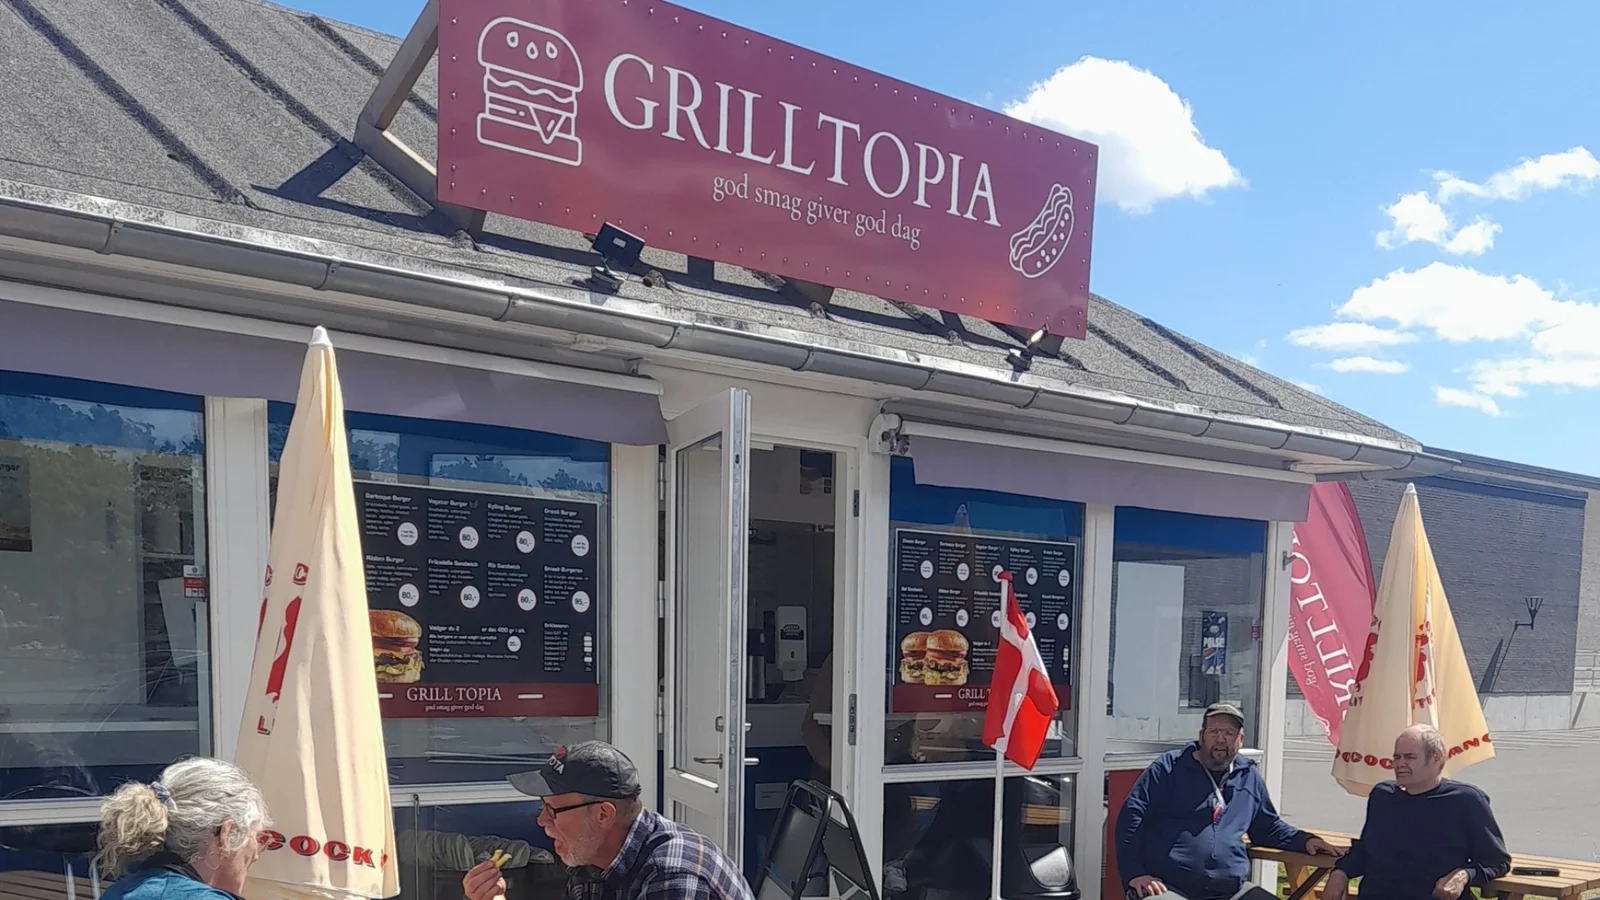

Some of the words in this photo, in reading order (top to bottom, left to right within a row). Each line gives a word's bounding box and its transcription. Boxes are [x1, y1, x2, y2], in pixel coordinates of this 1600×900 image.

[604, 53, 1001, 228] GRILLTOPIA
[713, 173, 749, 202] god
[755, 186, 802, 221] smag
[806, 197, 851, 224] giver
[855, 210, 886, 237] god
[891, 214, 921, 250] dag
[392, 494, 412, 502] Burger
[450, 500, 468, 508] Burger
[504, 504, 522, 513] Burger
[462, 534, 476, 542] 80,-
[386, 556, 405, 564] Burger
[402, 592, 416, 600] 80,-
[463, 594, 477, 602] 80,-
[406, 687, 452, 700] GRILL
[456, 687, 502, 700] TOPIA
[958, 688, 986, 700] GRILL
